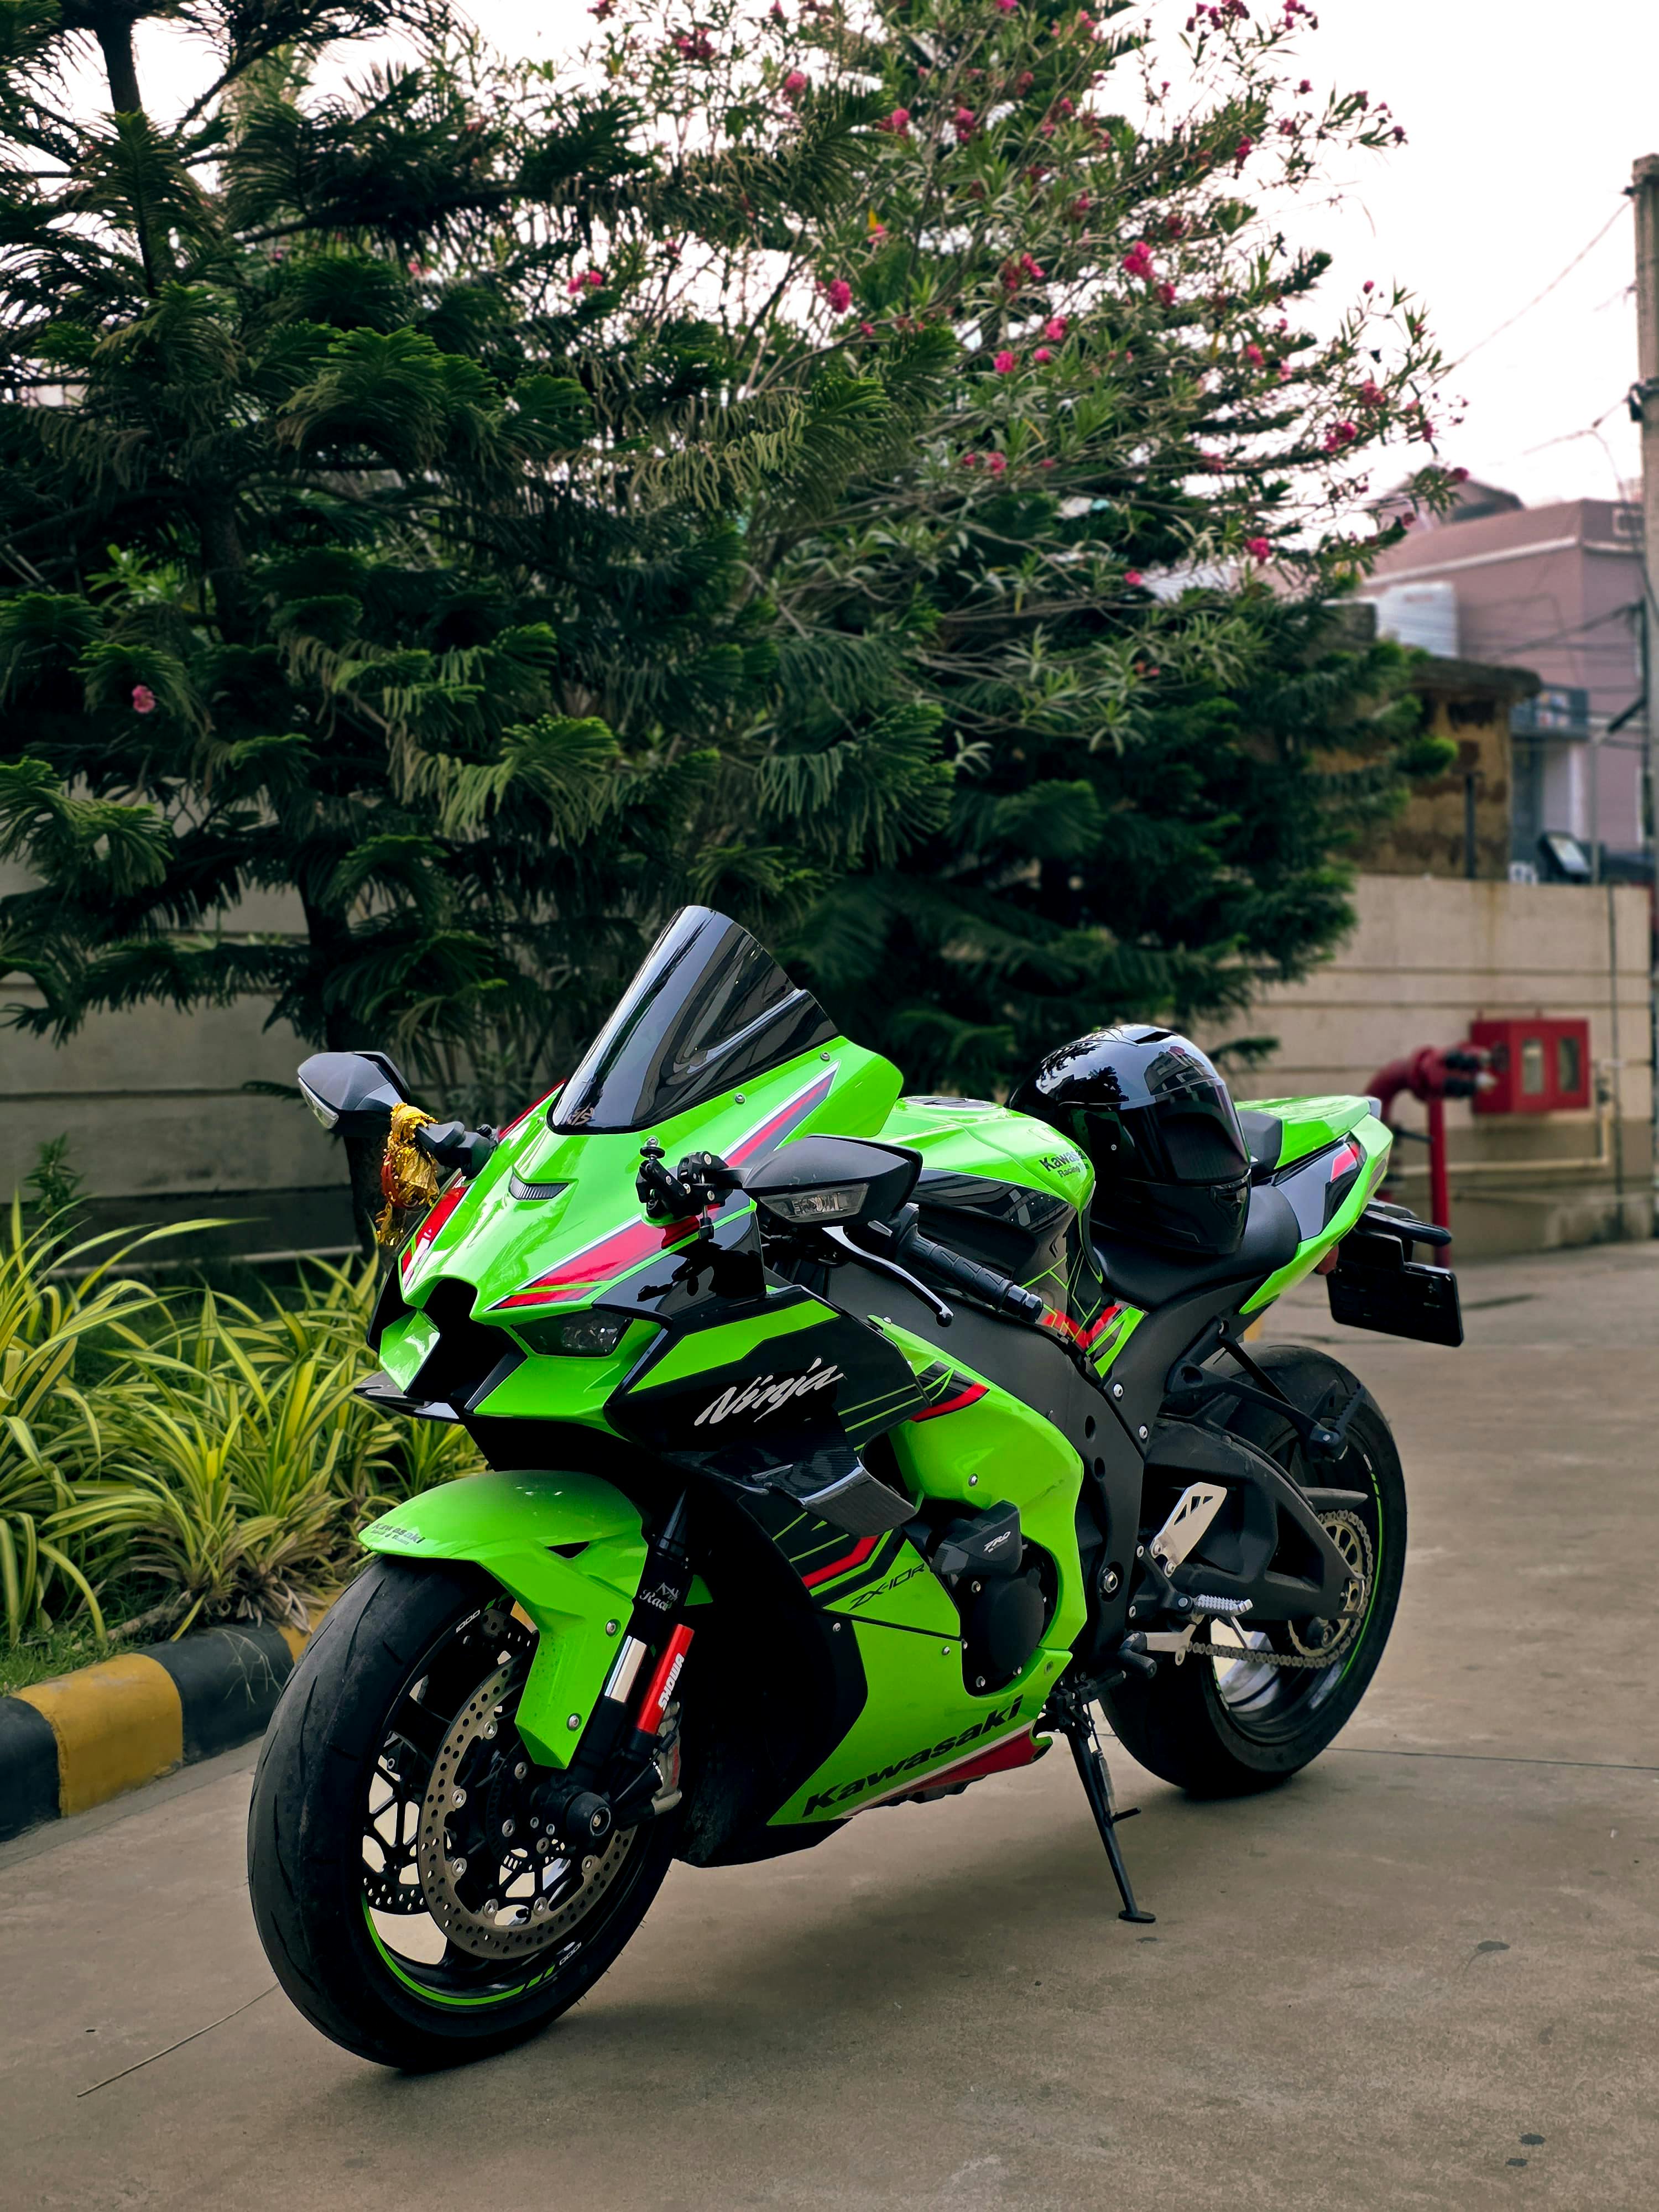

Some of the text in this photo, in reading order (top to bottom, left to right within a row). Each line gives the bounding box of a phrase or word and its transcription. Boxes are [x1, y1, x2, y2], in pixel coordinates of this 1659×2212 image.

[694, 1357, 844, 1426] Ninja
[848, 1563, 925, 1611] ZX-10R
[658, 1652, 685, 1713] SHOWA
[802, 1694, 1024, 1818] Kawasaki
